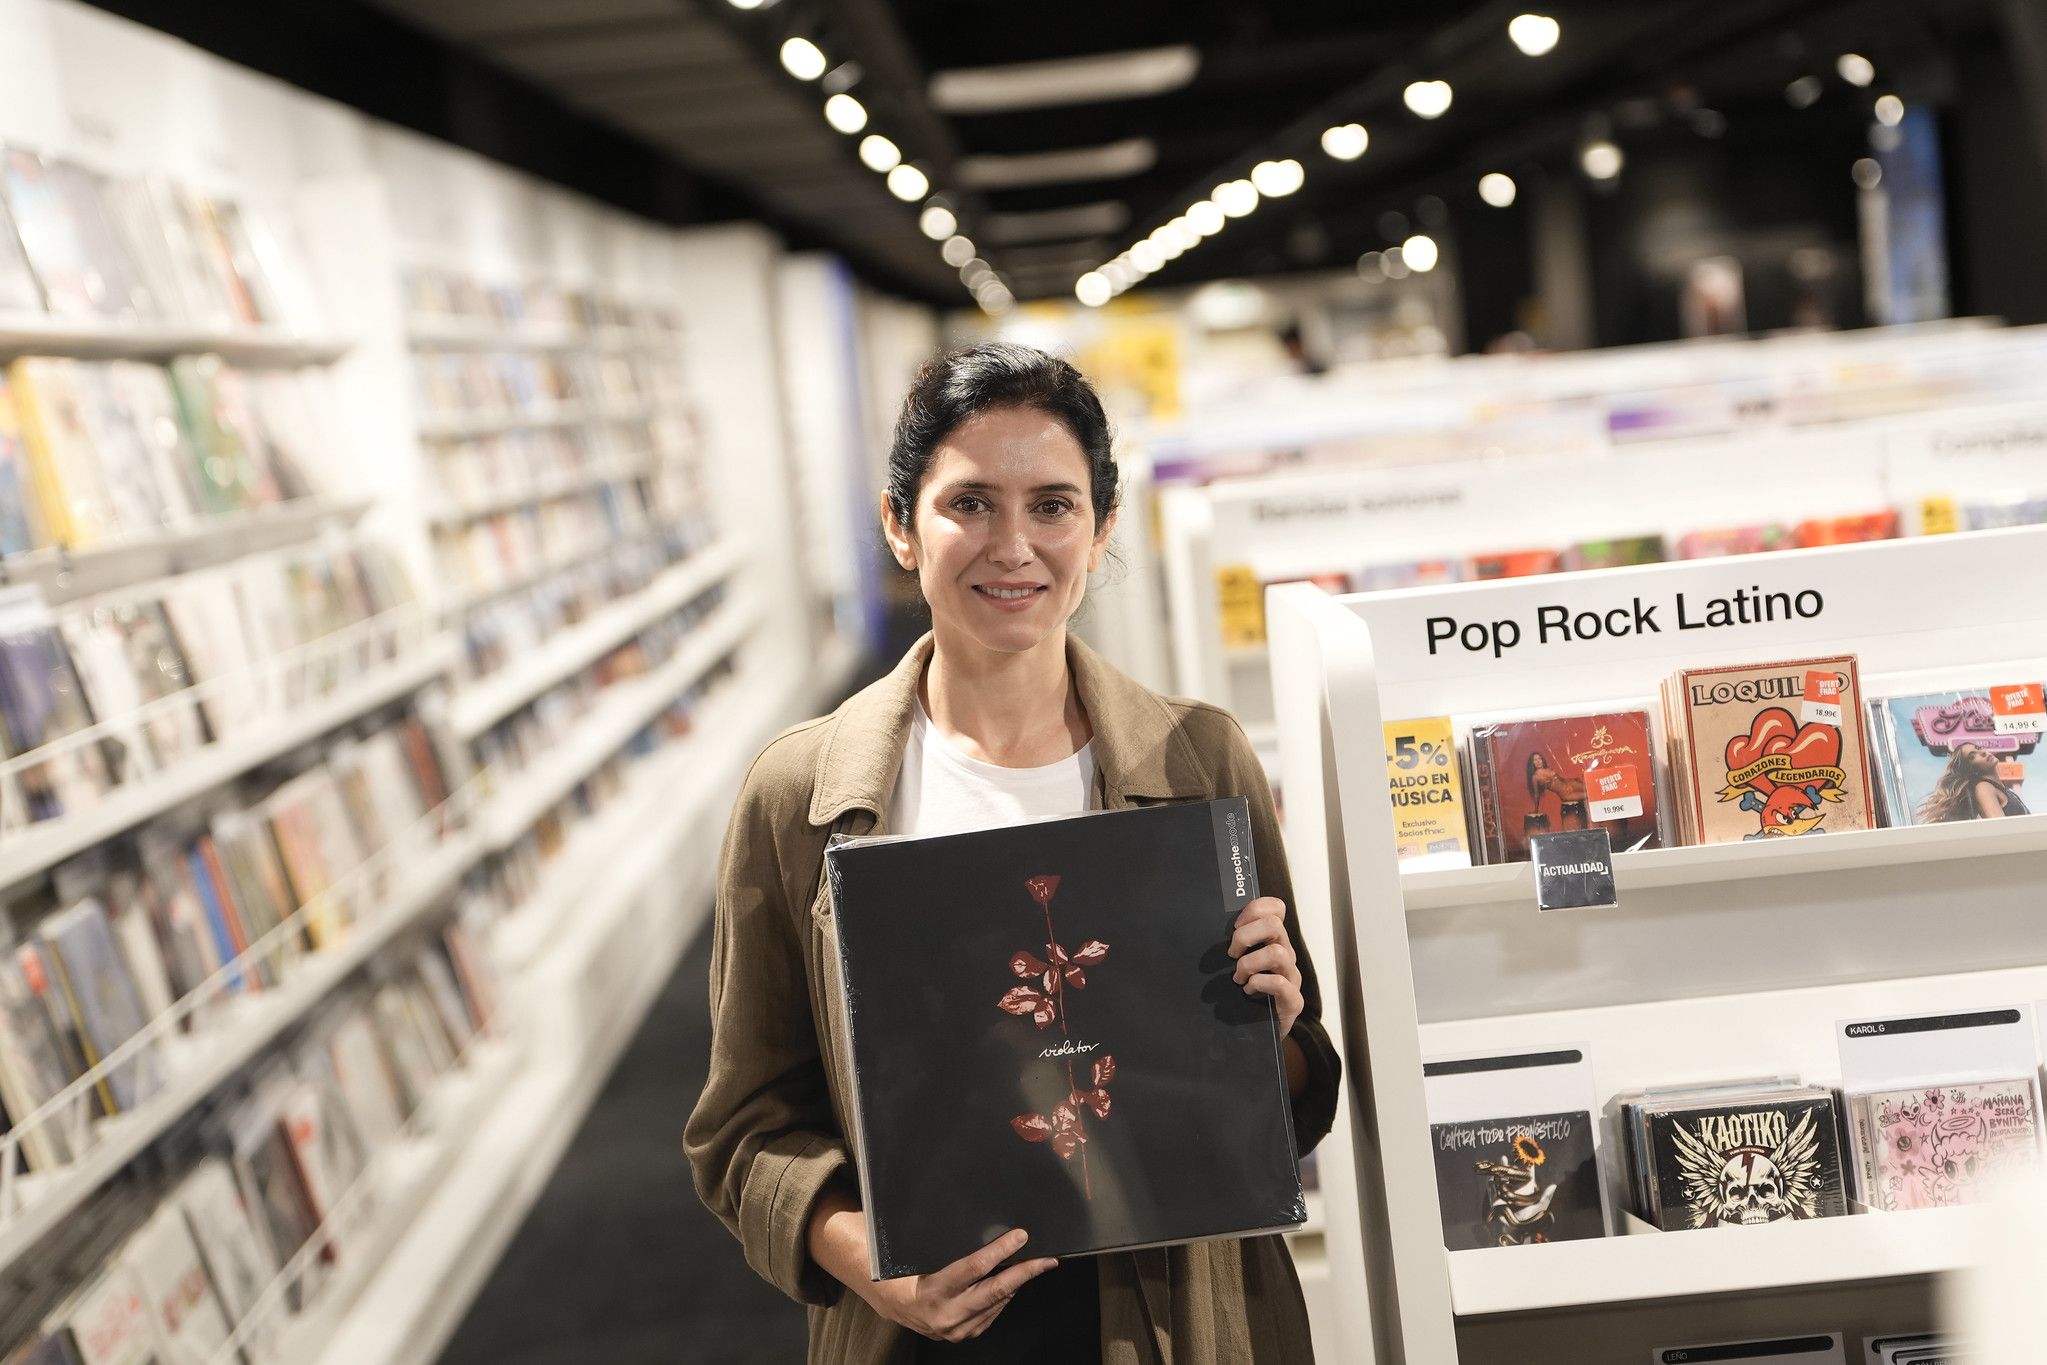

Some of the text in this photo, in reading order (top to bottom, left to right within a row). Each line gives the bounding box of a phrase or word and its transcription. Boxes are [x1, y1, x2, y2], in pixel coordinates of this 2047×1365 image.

[1426, 585, 1824, 658] Pop Rock Latino
[1692, 672, 1850, 706] LOQUILO
[1820, 680, 1840, 688] OFERT
[1732, 757, 1842, 783] CORAZONES LEGENDARIOS
[1389, 773, 1450, 789] ALDO EN
[1402, 819, 1437, 829] Exclusivo
[1398, 829, 1423, 838] Socios
[1543, 861, 1604, 877] ACTUALIDAD
[1850, 1024, 1886, 1035] KAROL G
[1038, 1039, 1100, 1058] violator
[1983, 1093, 2025, 1110] MAÑANA
[1699, 1109, 1789, 1153] KAOTIKO
